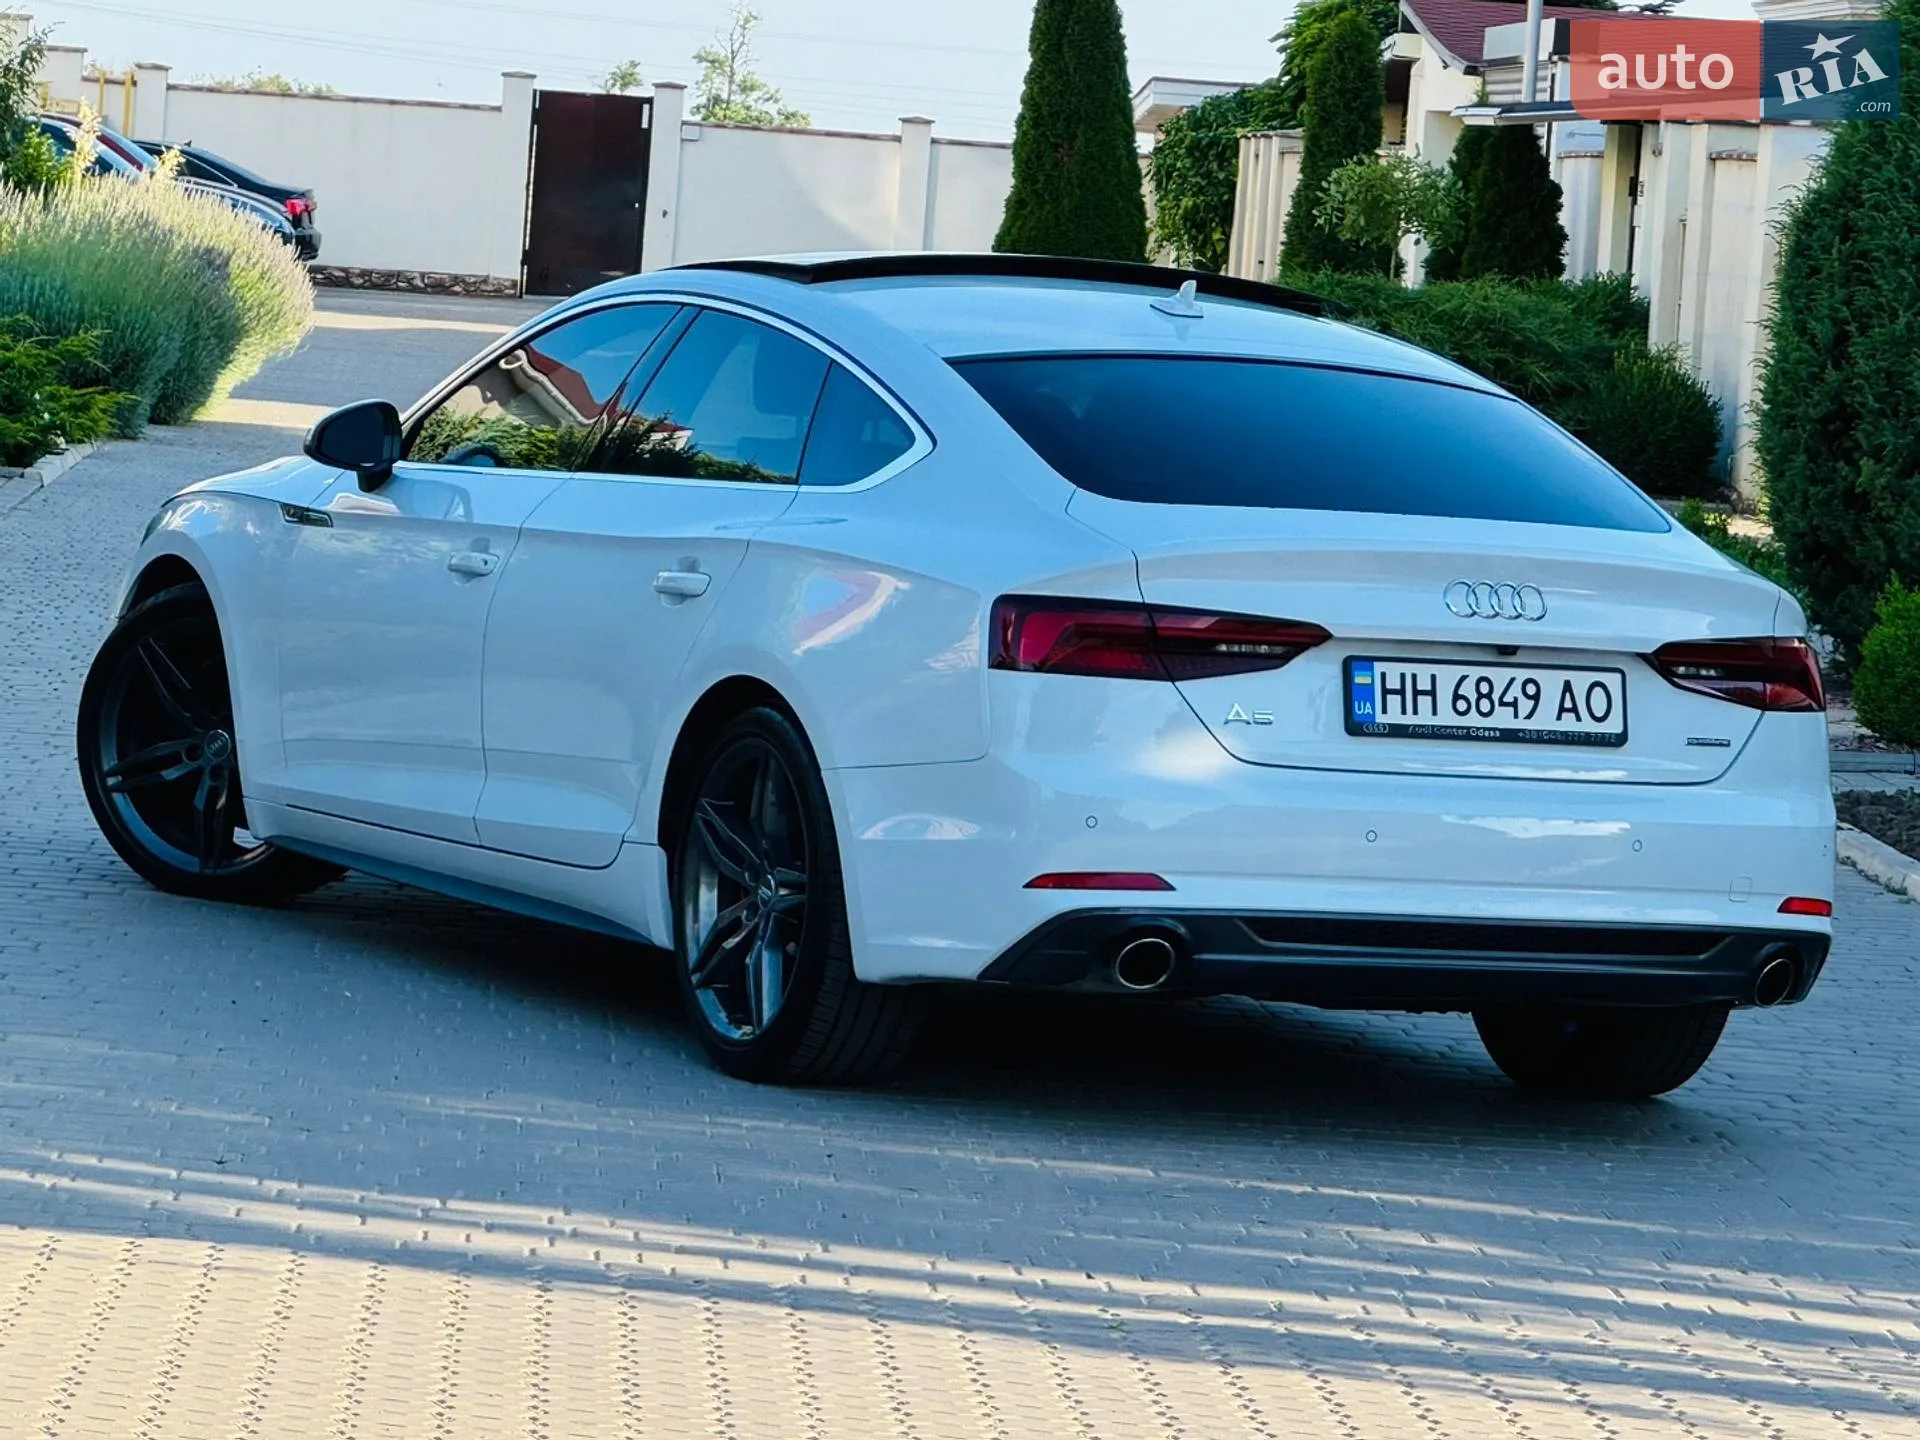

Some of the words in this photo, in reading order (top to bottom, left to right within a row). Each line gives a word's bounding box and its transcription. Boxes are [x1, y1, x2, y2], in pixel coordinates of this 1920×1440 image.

[1354, 701, 1373, 715] UA
[1380, 671, 1438, 716] HH
[1451, 674, 1541, 720] 6849
[1555, 679, 1613, 723] AO
[1224, 703, 1274, 725] A5
